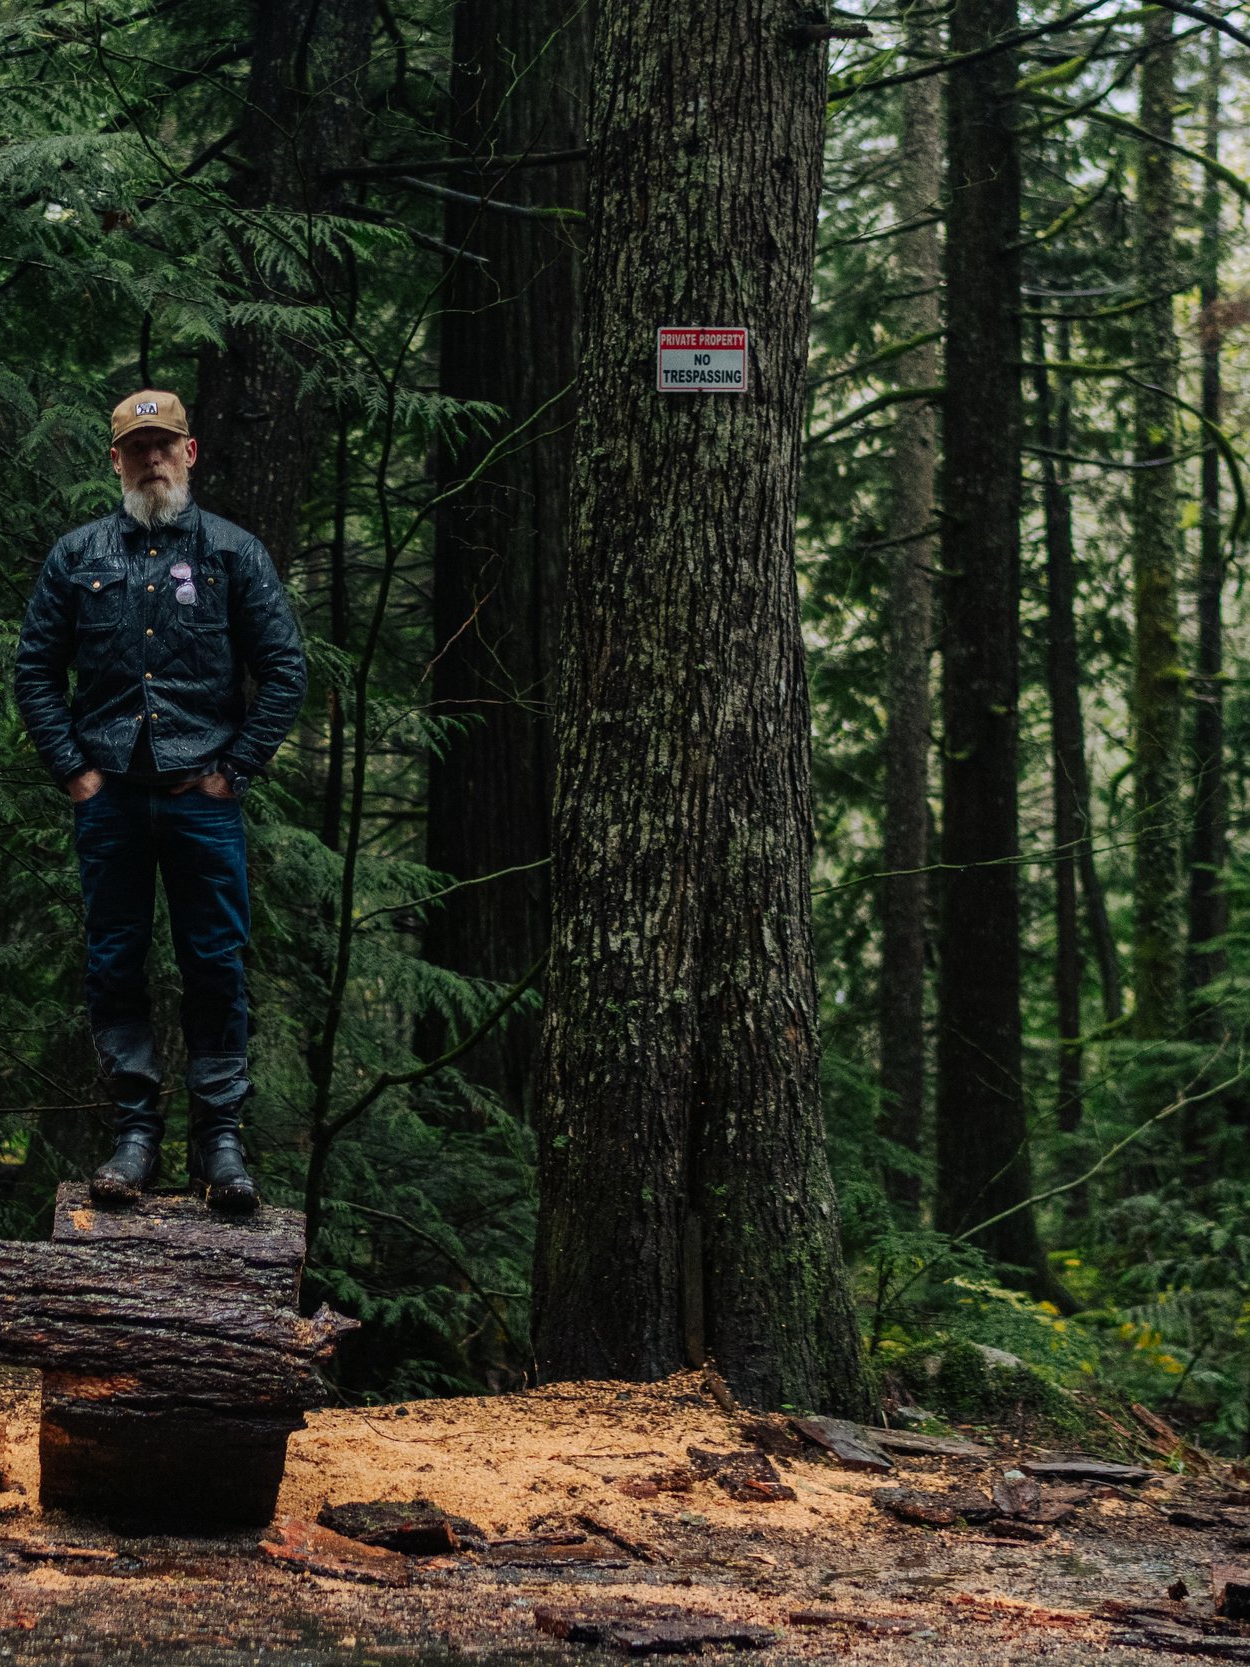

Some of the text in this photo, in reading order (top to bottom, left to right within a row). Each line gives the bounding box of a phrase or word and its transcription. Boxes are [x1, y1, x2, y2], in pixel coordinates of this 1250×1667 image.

[661, 333, 744, 346] PRIVATE PROPERTY
[694, 353, 711, 366] NO
[663, 370, 742, 383] TRESPASSING
